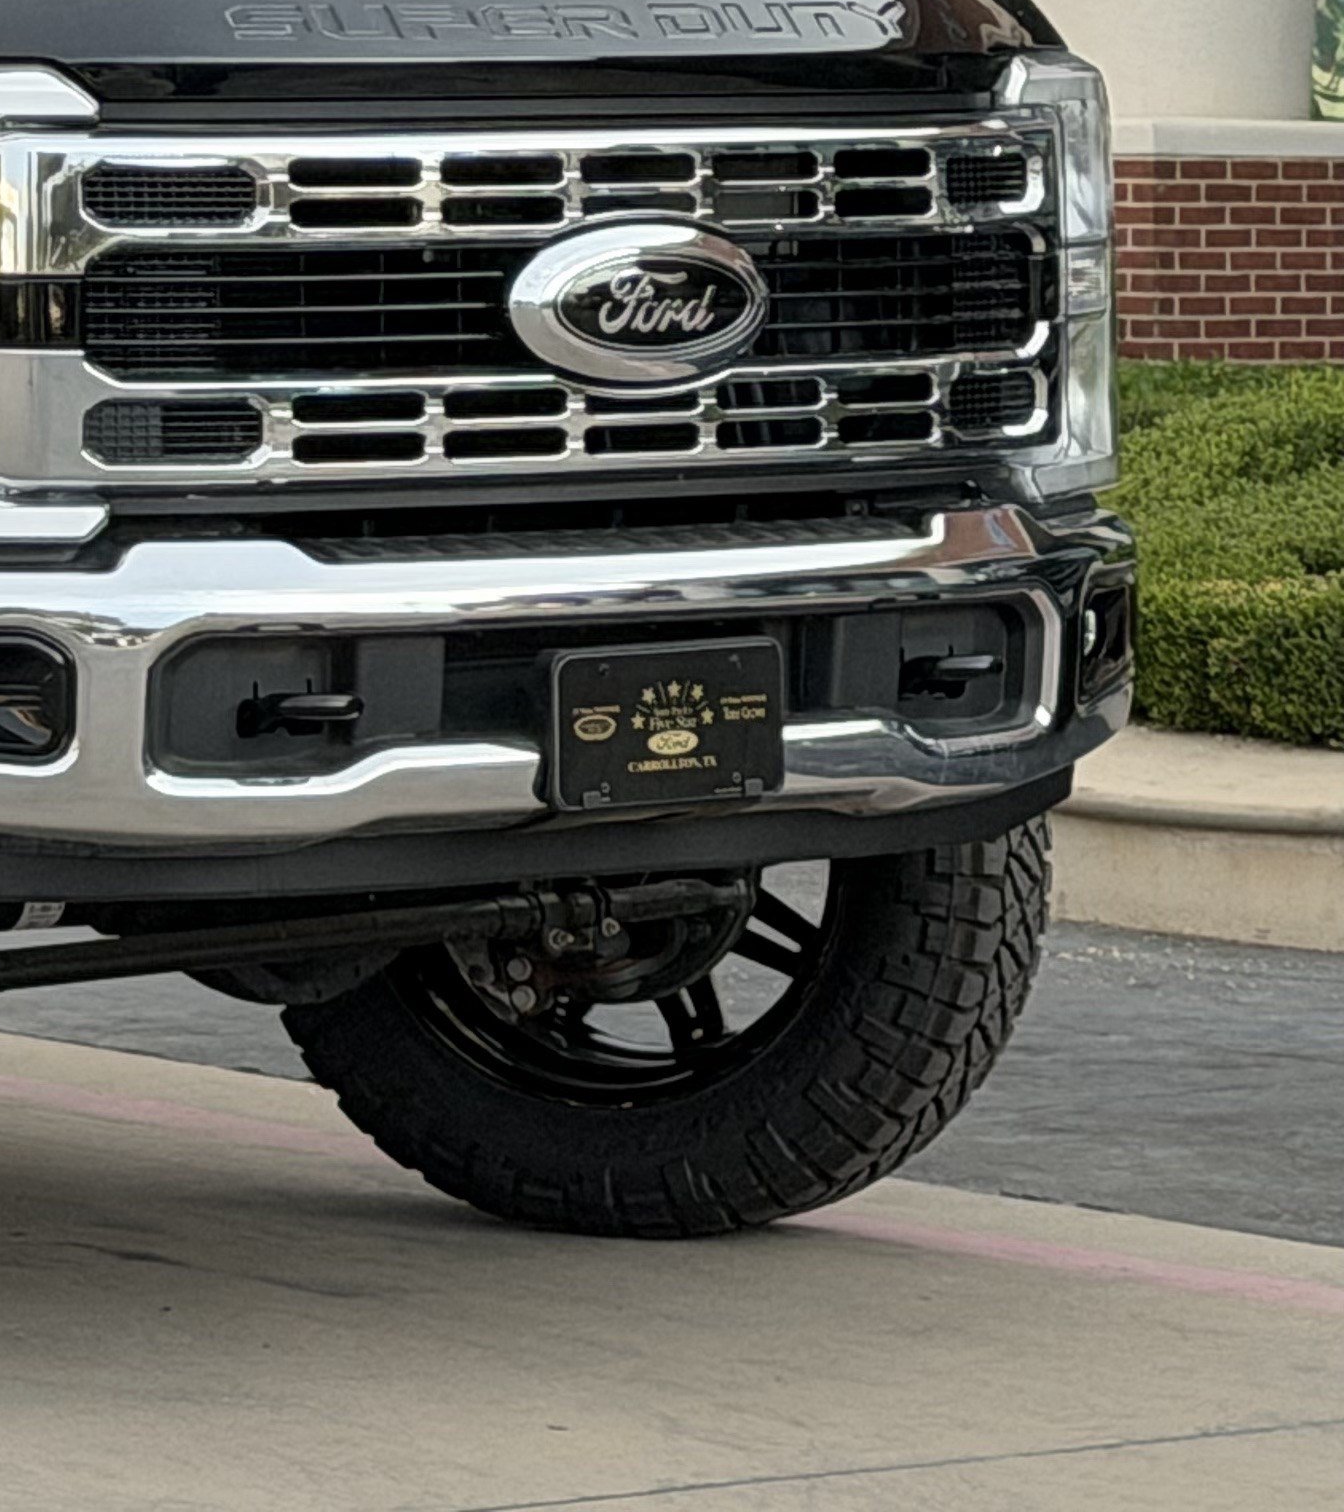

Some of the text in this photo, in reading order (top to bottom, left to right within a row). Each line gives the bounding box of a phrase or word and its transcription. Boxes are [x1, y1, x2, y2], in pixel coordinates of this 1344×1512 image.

[223, 0, 906, 40] SUPER DUTY
[598, 268, 718, 336] Ford
